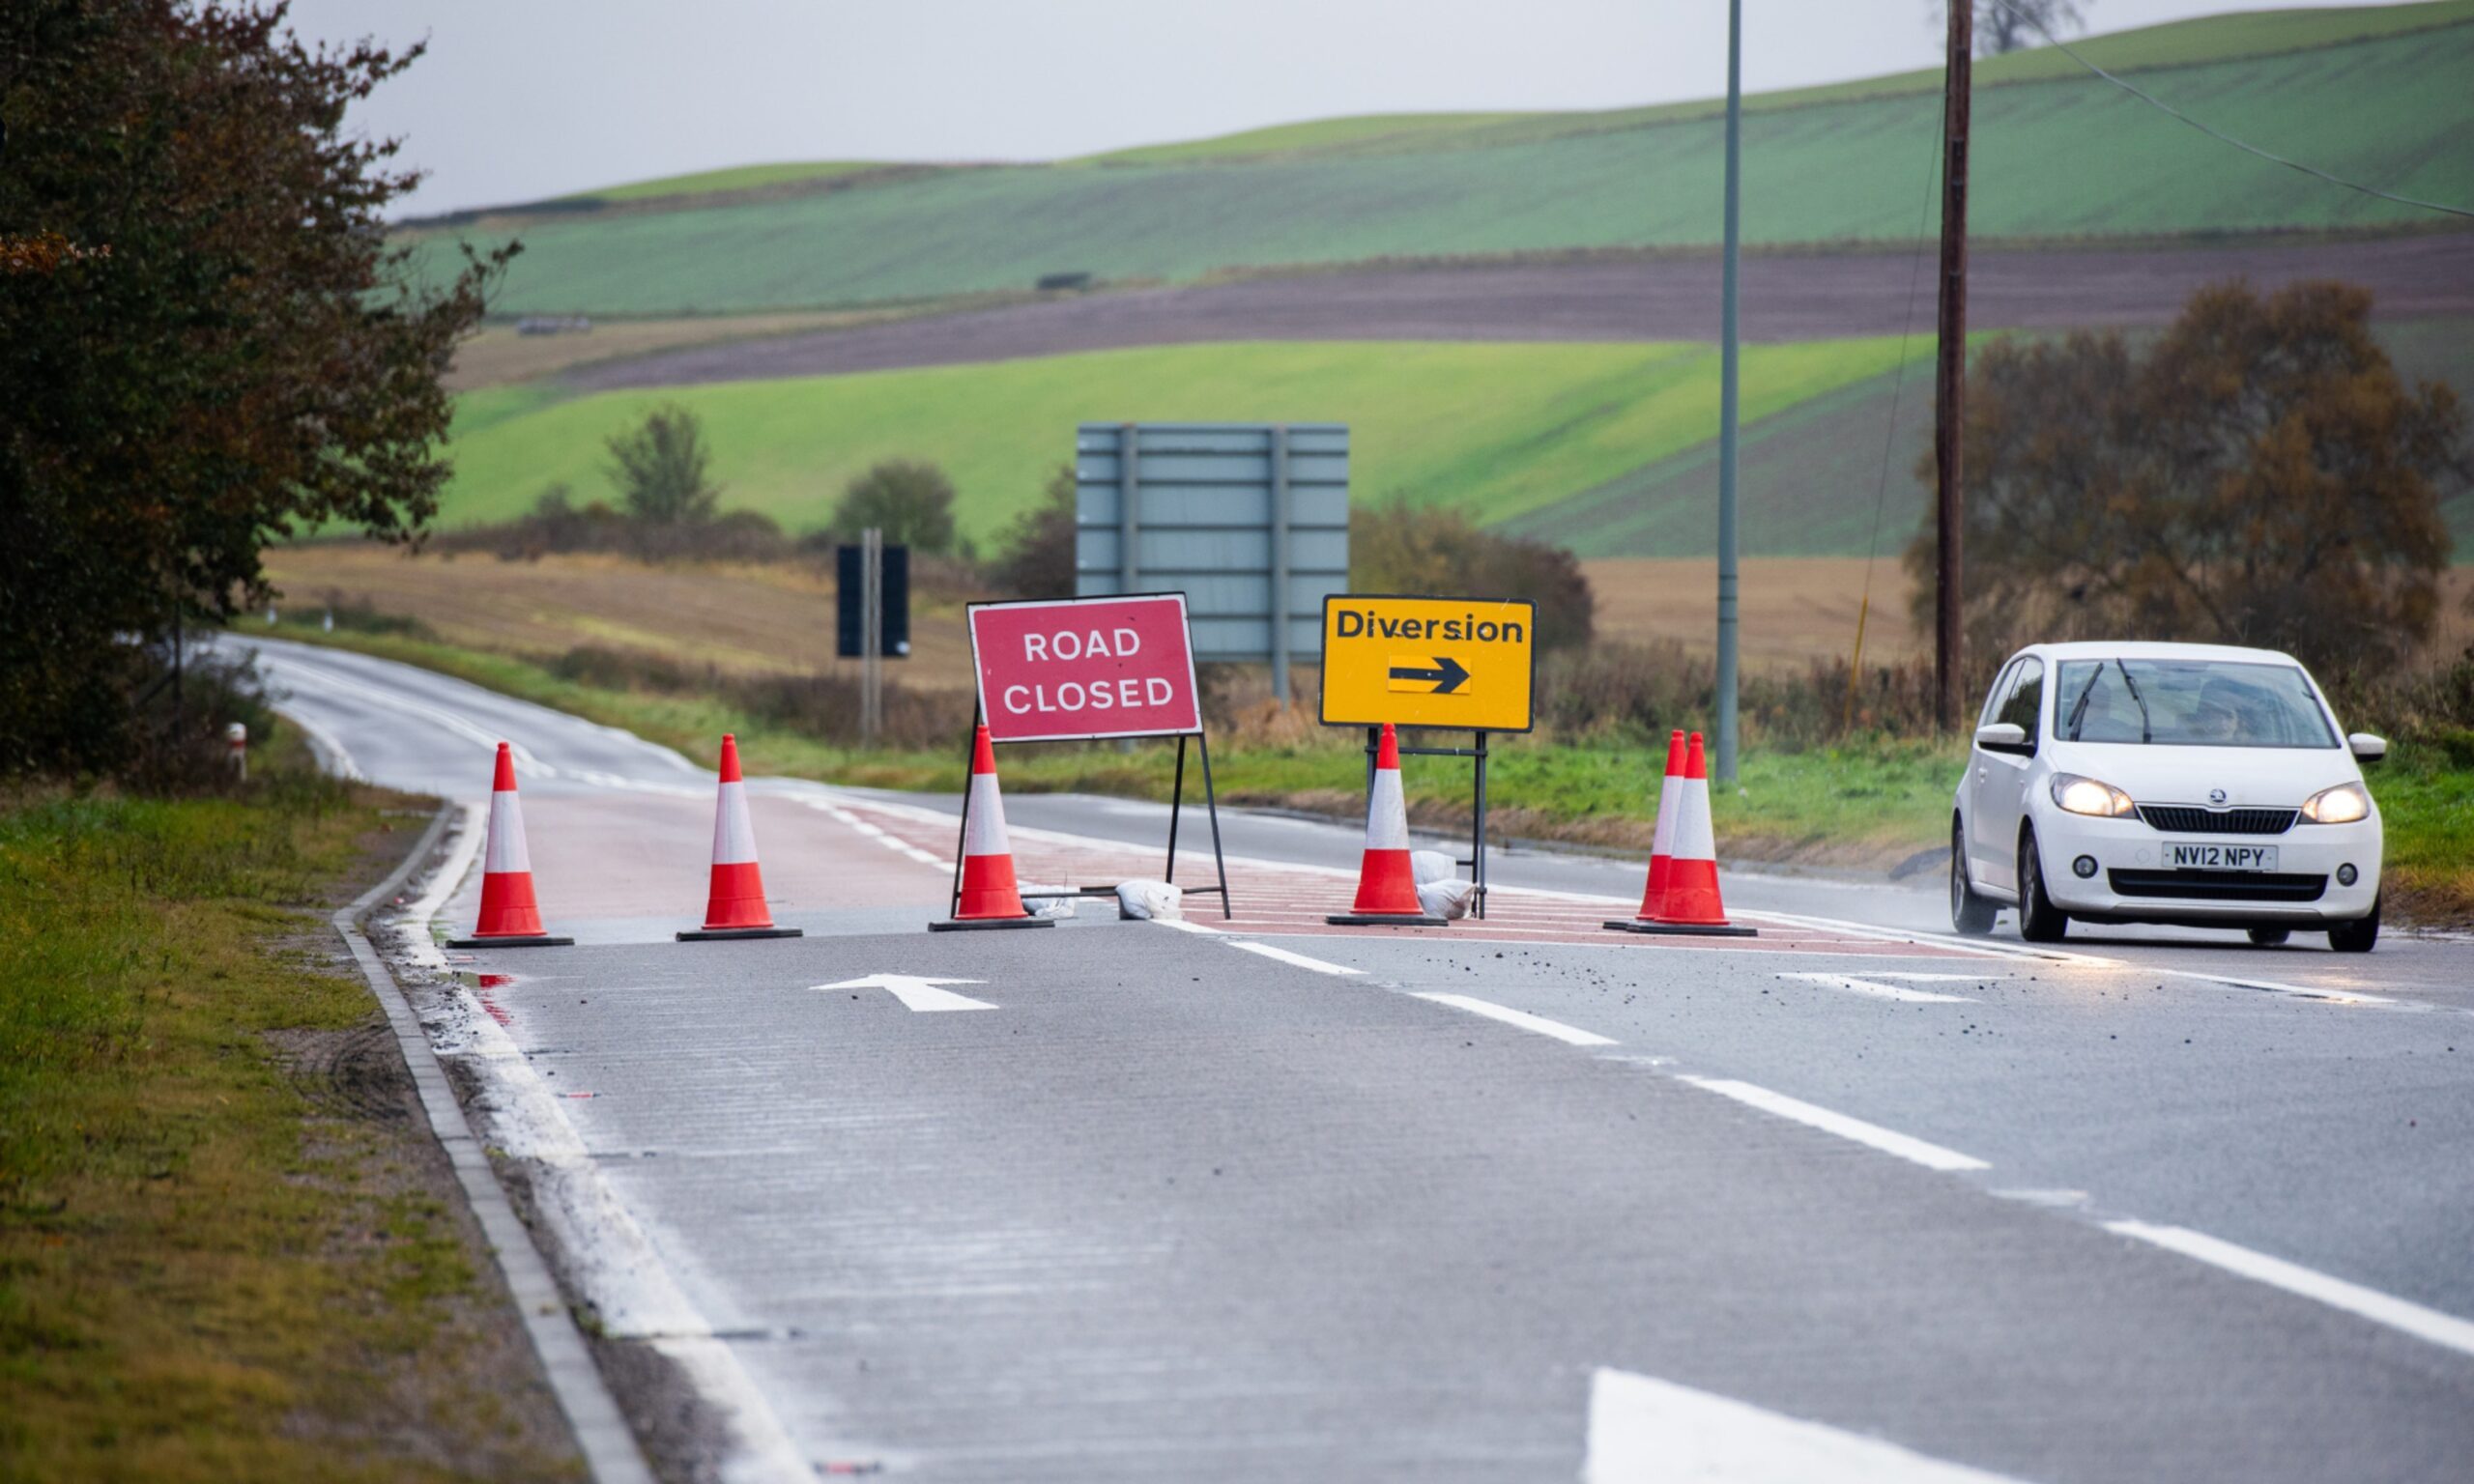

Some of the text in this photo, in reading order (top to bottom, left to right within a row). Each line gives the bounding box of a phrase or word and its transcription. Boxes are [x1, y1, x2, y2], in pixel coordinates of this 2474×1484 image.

[1337, 611, 1523, 642] Diversion
[1023, 628, 1140, 661] ROAD
[1004, 678, 1173, 714] CLOSED
[2174, 846, 2263, 867] NV12 NPY
